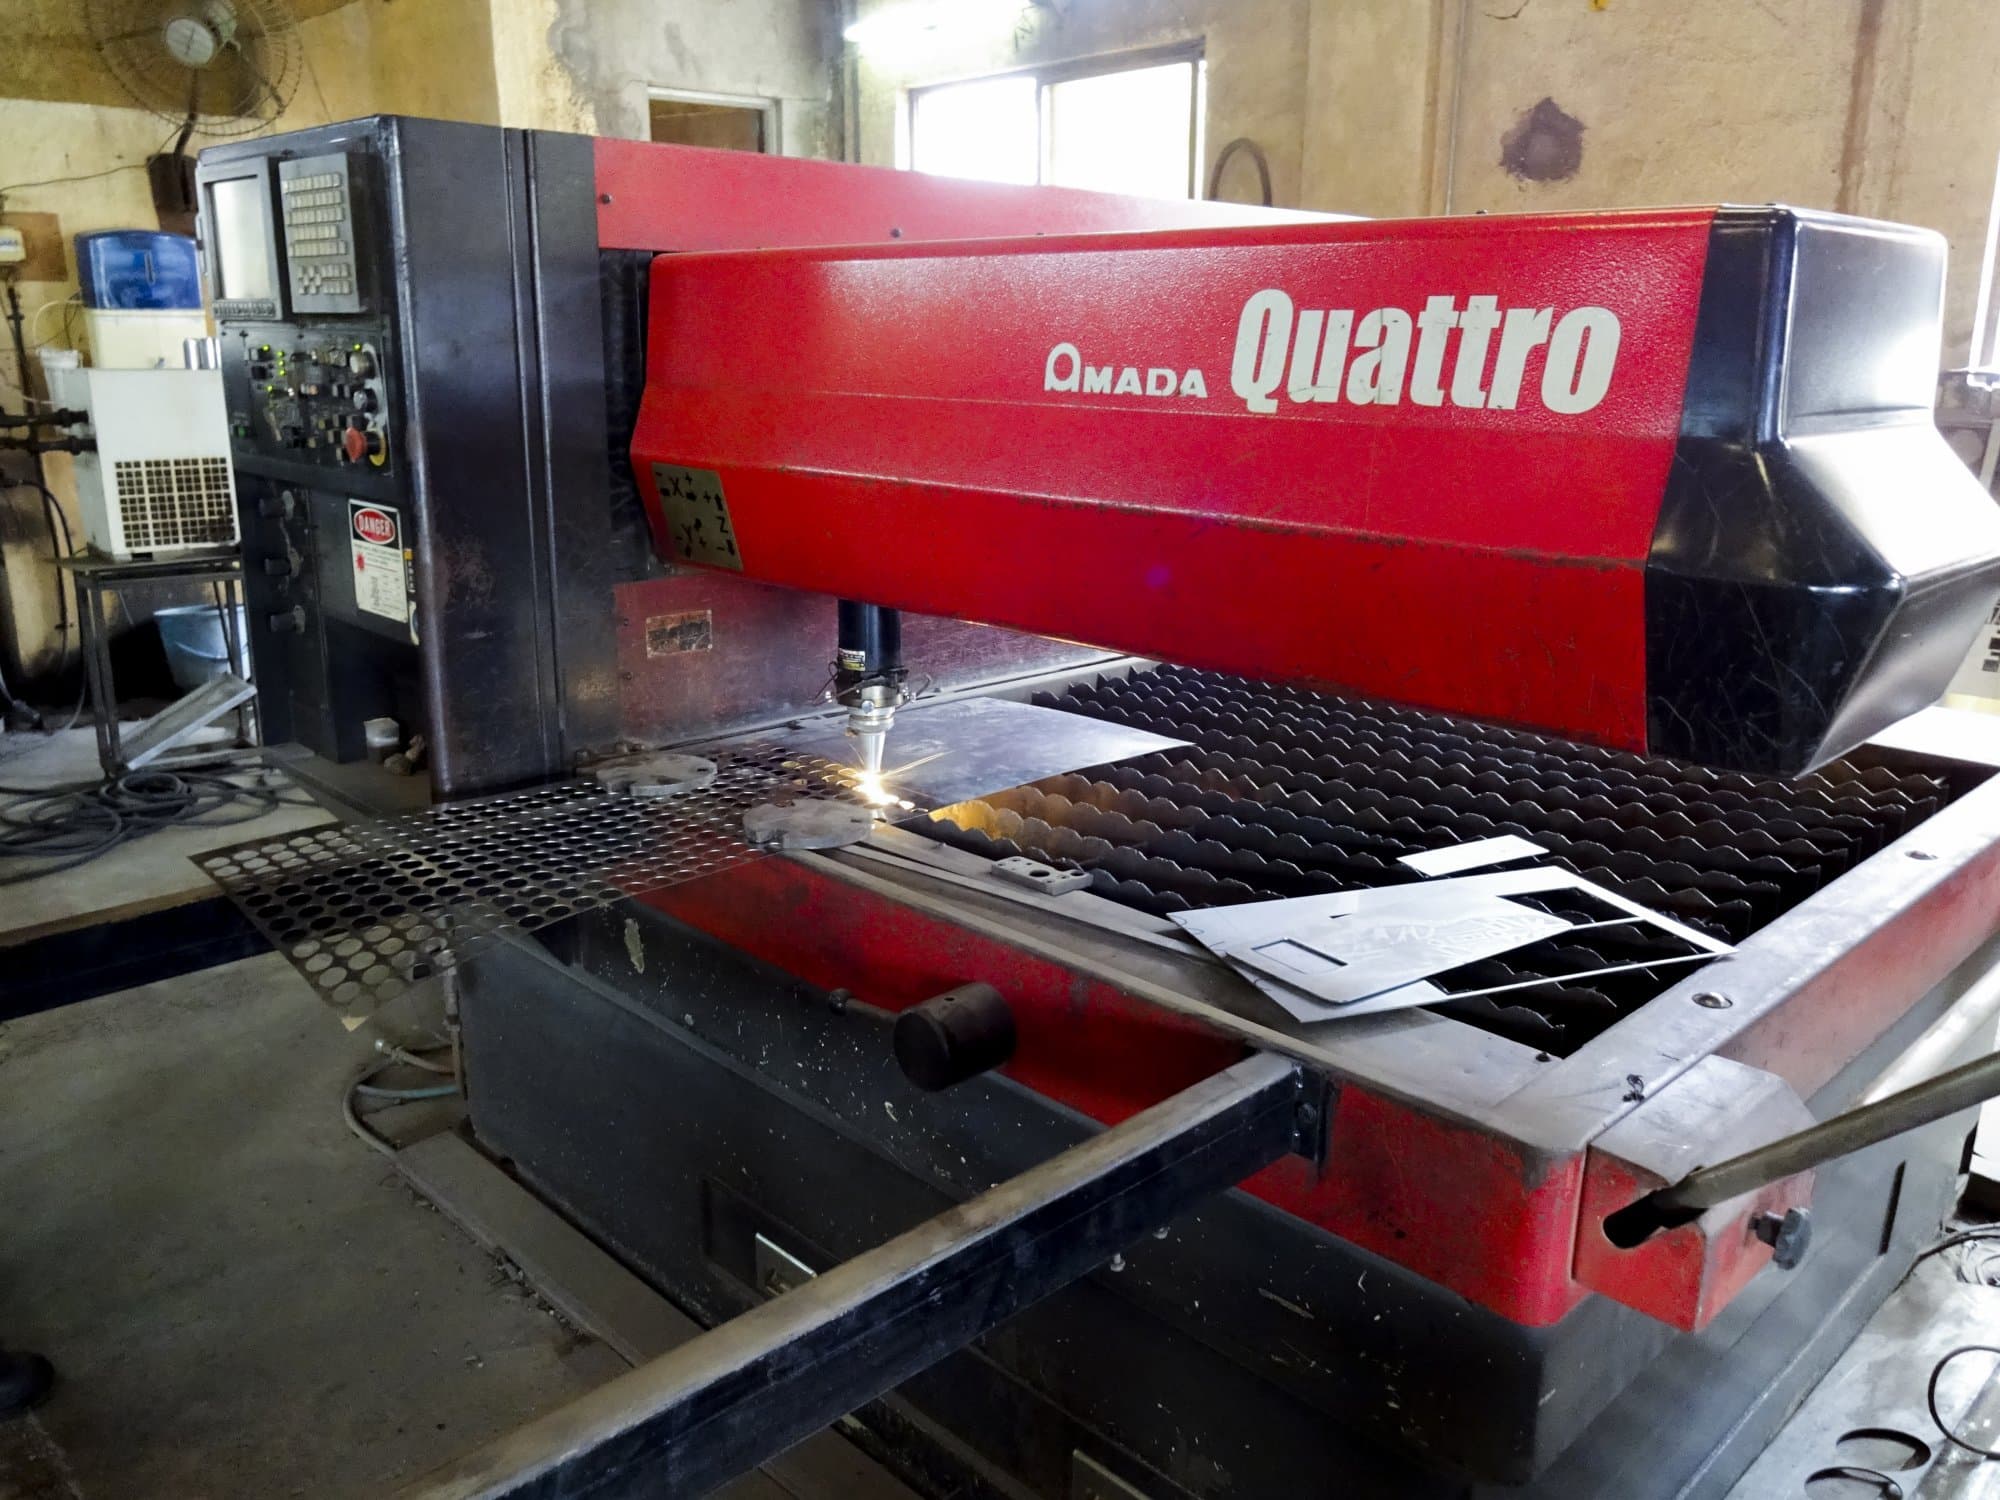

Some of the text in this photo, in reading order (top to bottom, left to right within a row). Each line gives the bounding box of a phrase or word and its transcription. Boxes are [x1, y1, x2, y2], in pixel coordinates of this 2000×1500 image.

[1044, 288, 1621, 415] AMADA Quattro
[358, 514, 392, 537] DANGER
